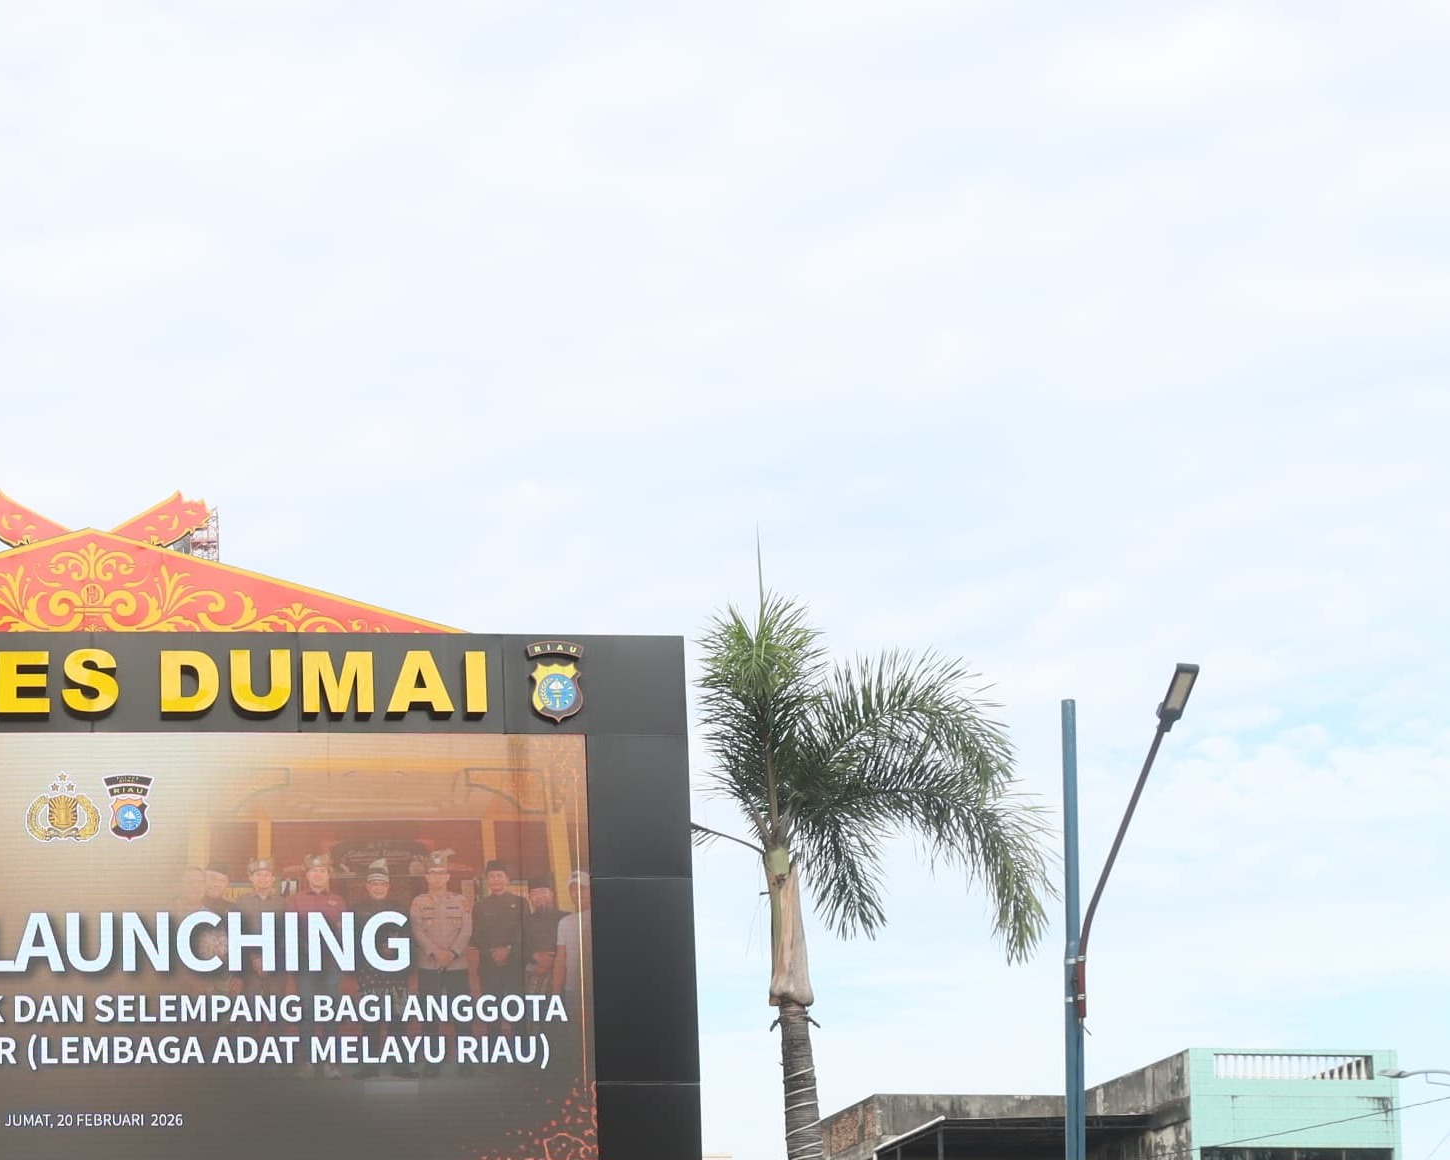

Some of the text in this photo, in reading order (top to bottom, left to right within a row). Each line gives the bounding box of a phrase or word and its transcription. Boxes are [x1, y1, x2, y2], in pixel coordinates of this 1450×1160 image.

[534, 644, 577, 653] RIAU
[159, 647, 489, 714] DUMAI
[113, 785, 144, 795] RIAU
[14, 995, 84, 1023] DAN
[94, 994, 302, 1023] SELEMPANG
[314, 994, 392, 1022] BAGI
[401, 994, 568, 1022] ANGGOTA
[27, 1034, 206, 1070] (LEMBAGA
[211, 1036, 300, 1064] ADAT
[311, 1036, 446, 1064] MELAYU
[457, 1033, 550, 1069] RIAU)
[5, 1113, 183, 1129] JUMAT, 20 FEBRUARI 2026
